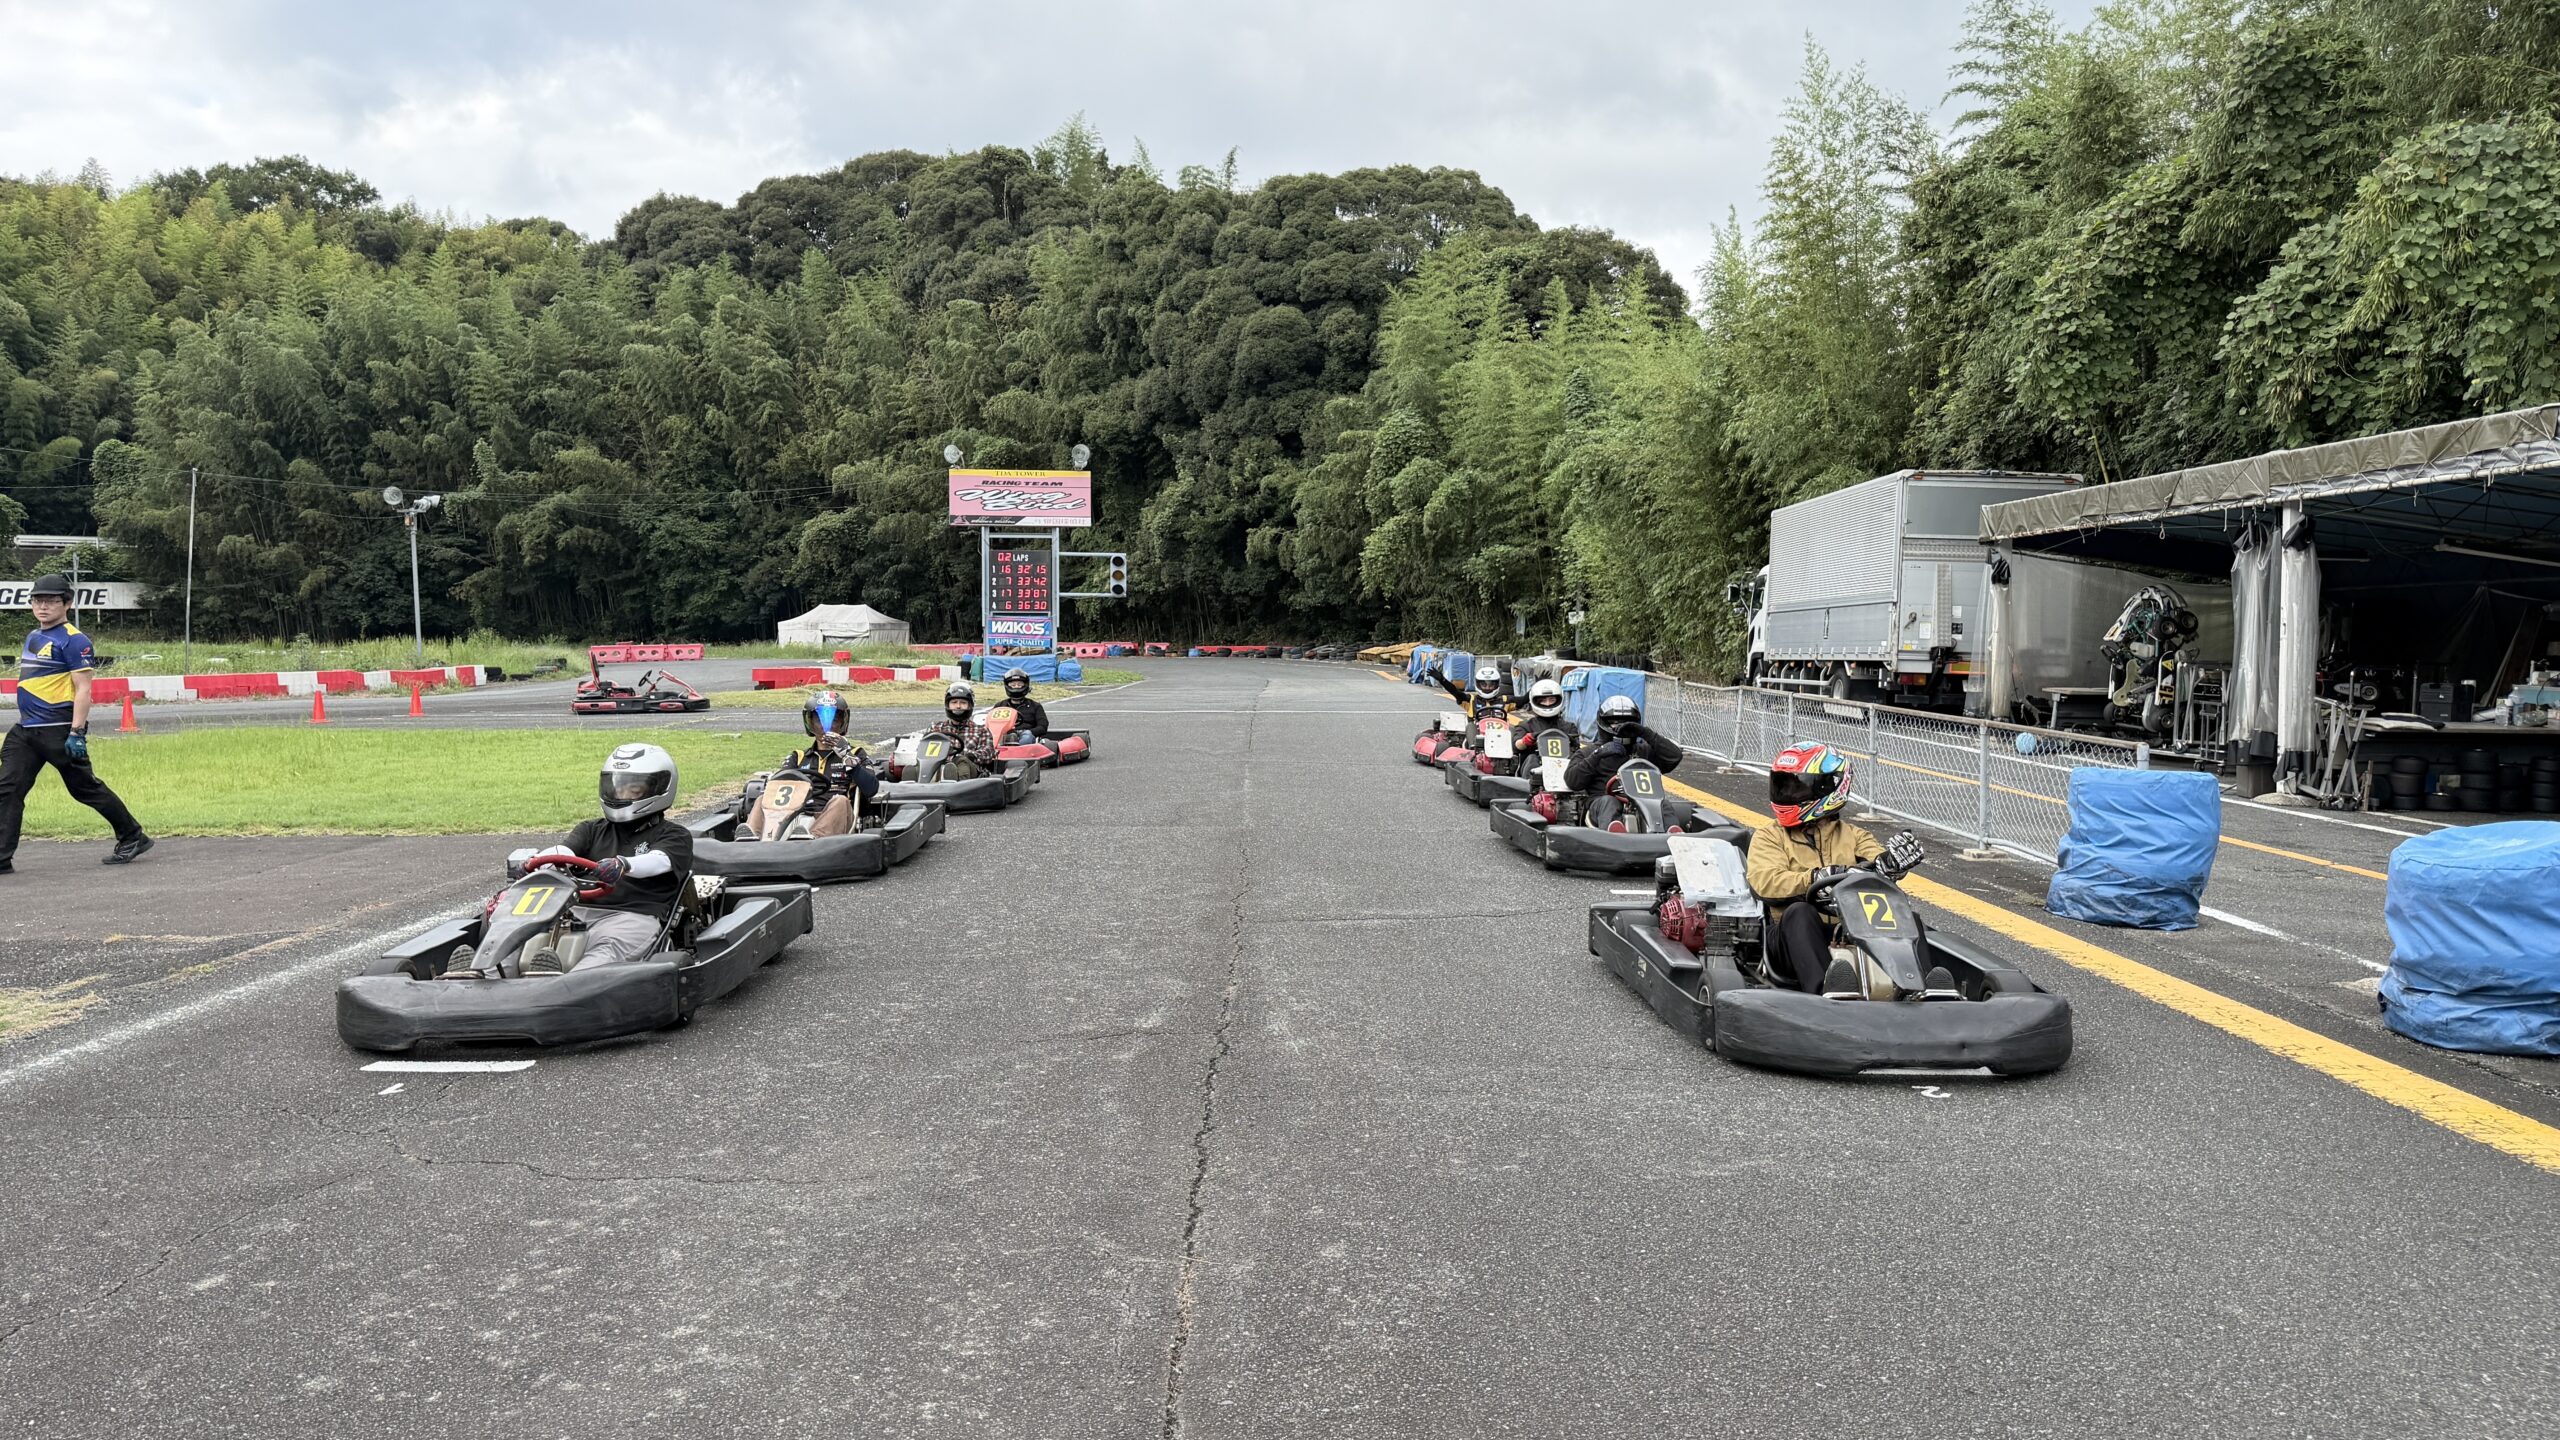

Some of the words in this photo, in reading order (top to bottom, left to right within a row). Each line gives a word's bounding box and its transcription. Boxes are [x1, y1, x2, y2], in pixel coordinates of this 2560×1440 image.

[998, 552, 1012, 561] 02
[992, 566, 996, 574] 1
[1001, 564, 1012, 574] 16
[992, 578, 996, 586] 2
[1006, 576, 1012, 586] 7
[992, 590, 996, 598] 3
[1001, 589, 1012, 598] 17
[992, 602, 996, 610] 4
[1006, 601, 1012, 610] 6
[992, 710, 1010, 719] 83
[928, 742, 940, 756] 7
[1550, 740, 1560, 755] 8
[1635, 772, 1651, 792] 6
[774, 786, 793, 806] 3
[530, 888, 549, 914] 1
[1864, 894, 1894, 928] 2
